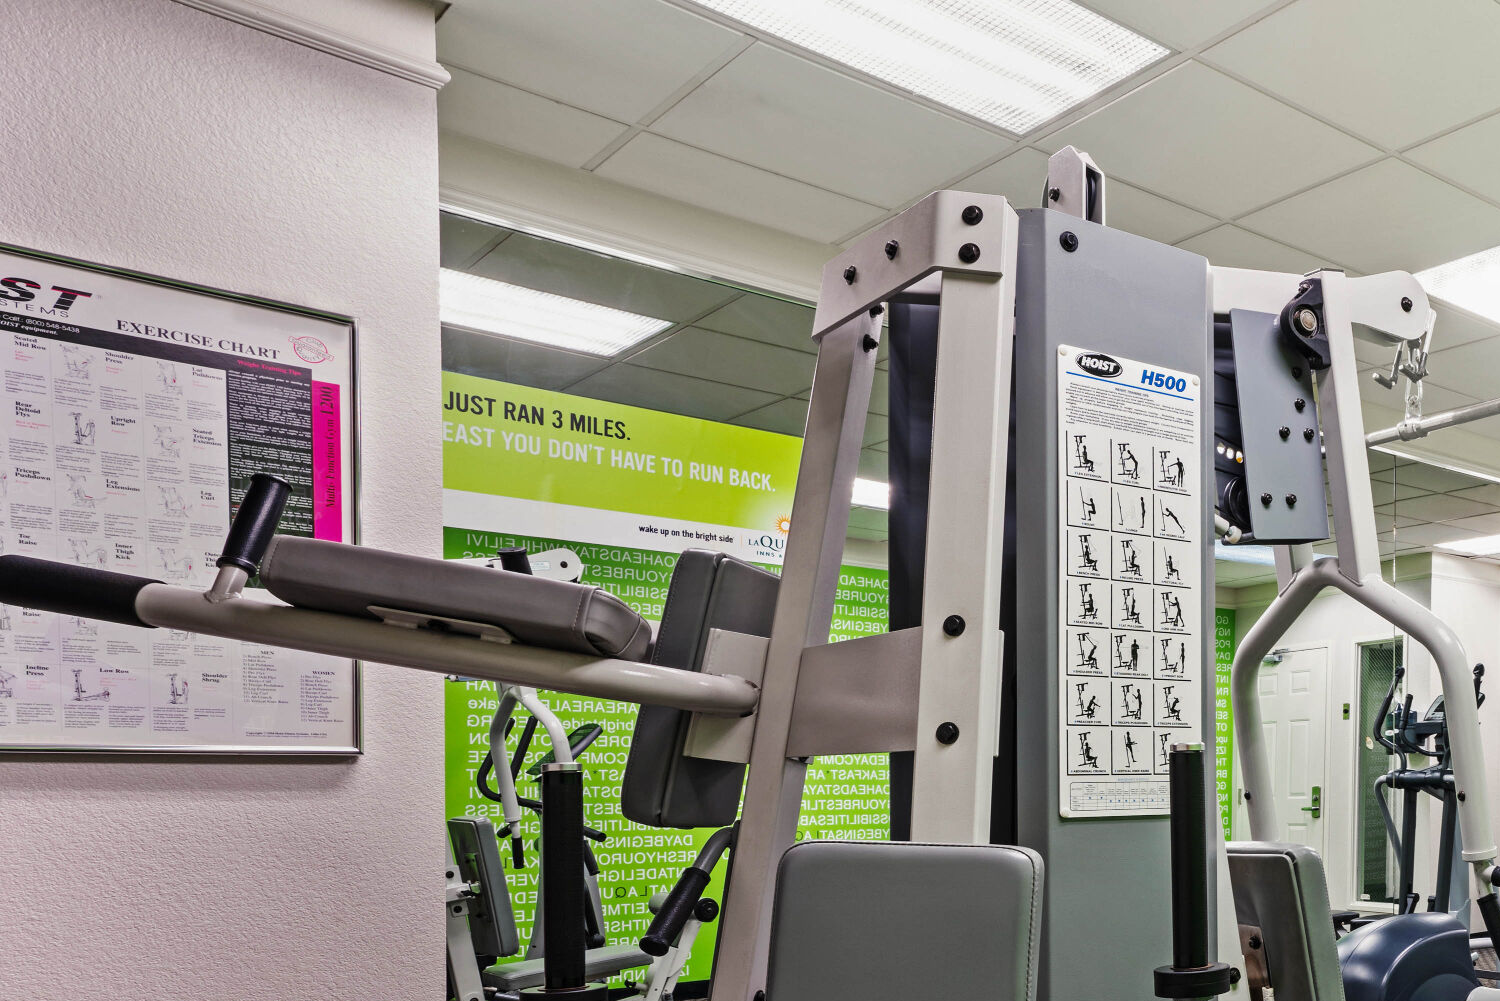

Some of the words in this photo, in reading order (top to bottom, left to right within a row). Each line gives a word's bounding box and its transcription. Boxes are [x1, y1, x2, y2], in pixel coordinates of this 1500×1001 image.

[21, 324, 58, 335] equipment.
[25, 318, 45, 327] (800)
[46, 321, 80, 333] 548-5438
[31, 343, 47, 351] Row
[116, 319, 214, 348] EXERCISE
[218, 339, 280, 360] CHART
[105, 351, 134, 361] Shoulder
[1080, 354, 1117, 373] HOIST
[261, 363, 287, 374] Training
[1141, 369, 1187, 393] H500
[320, 386, 335, 416] 1200
[15, 406, 41, 415] Deltoid
[444, 391, 496, 417] JUST
[504, 401, 545, 426] RAN
[552, 409, 563, 429] 3
[570, 412, 631, 441] MILES.
[111, 415, 136, 424] Upright
[327, 419, 337, 439] Gym
[327, 441, 336, 479] Function
[442, 421, 496, 448] EAST
[501, 430, 541, 456] YOU
[548, 438, 605, 465] DON'T
[611, 448, 656, 474] HAVE
[661, 456, 683, 478] TO
[689, 461, 724, 484] RUN
[729, 468, 776, 493] BACK.
[15, 467, 41, 475] Triceps
[15, 472, 51, 481] Pushdown
[638, 524, 659, 535] wake
[660, 527, 669, 538] up
[671, 529, 680, 537] on
[682, 529, 694, 539] the
[695, 531, 717, 543] bright
[718, 534, 734, 544] side
